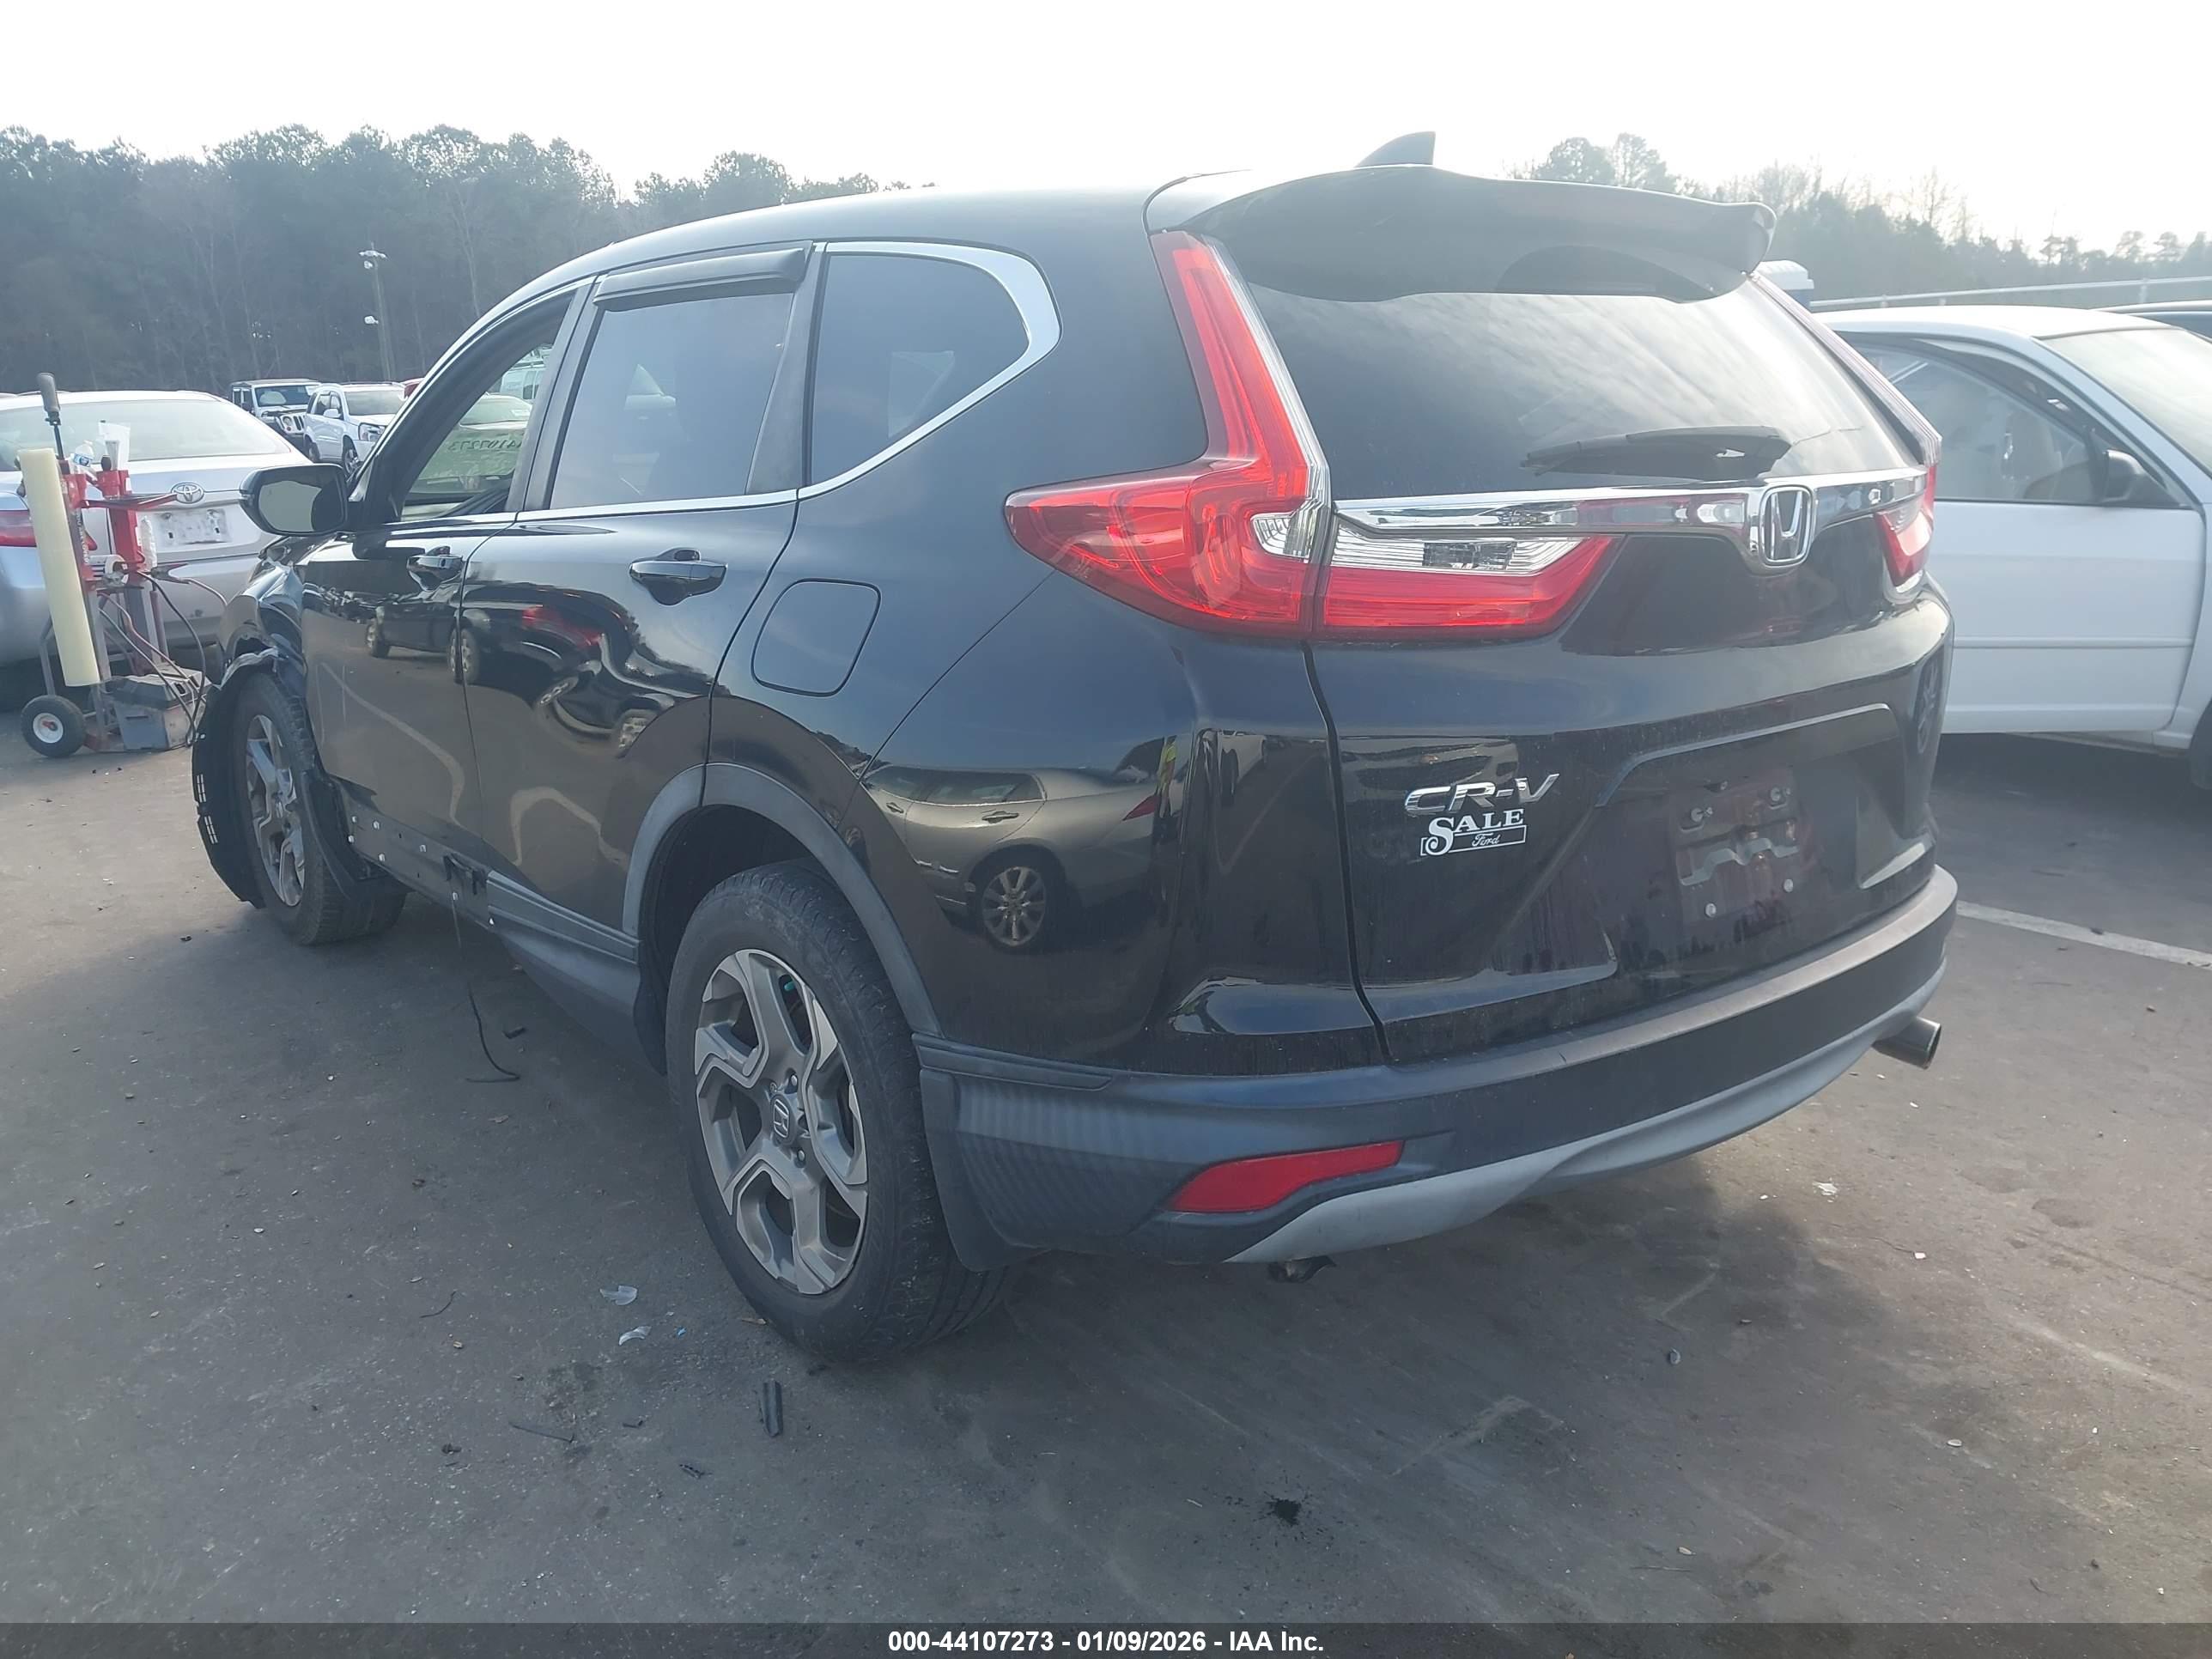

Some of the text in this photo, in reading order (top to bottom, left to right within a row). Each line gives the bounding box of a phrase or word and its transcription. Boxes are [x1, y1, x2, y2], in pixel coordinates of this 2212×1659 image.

[1405, 774, 1559, 811] CR-V
[1425, 808, 1525, 856] SALE
[1471, 832, 1500, 847] Ford
